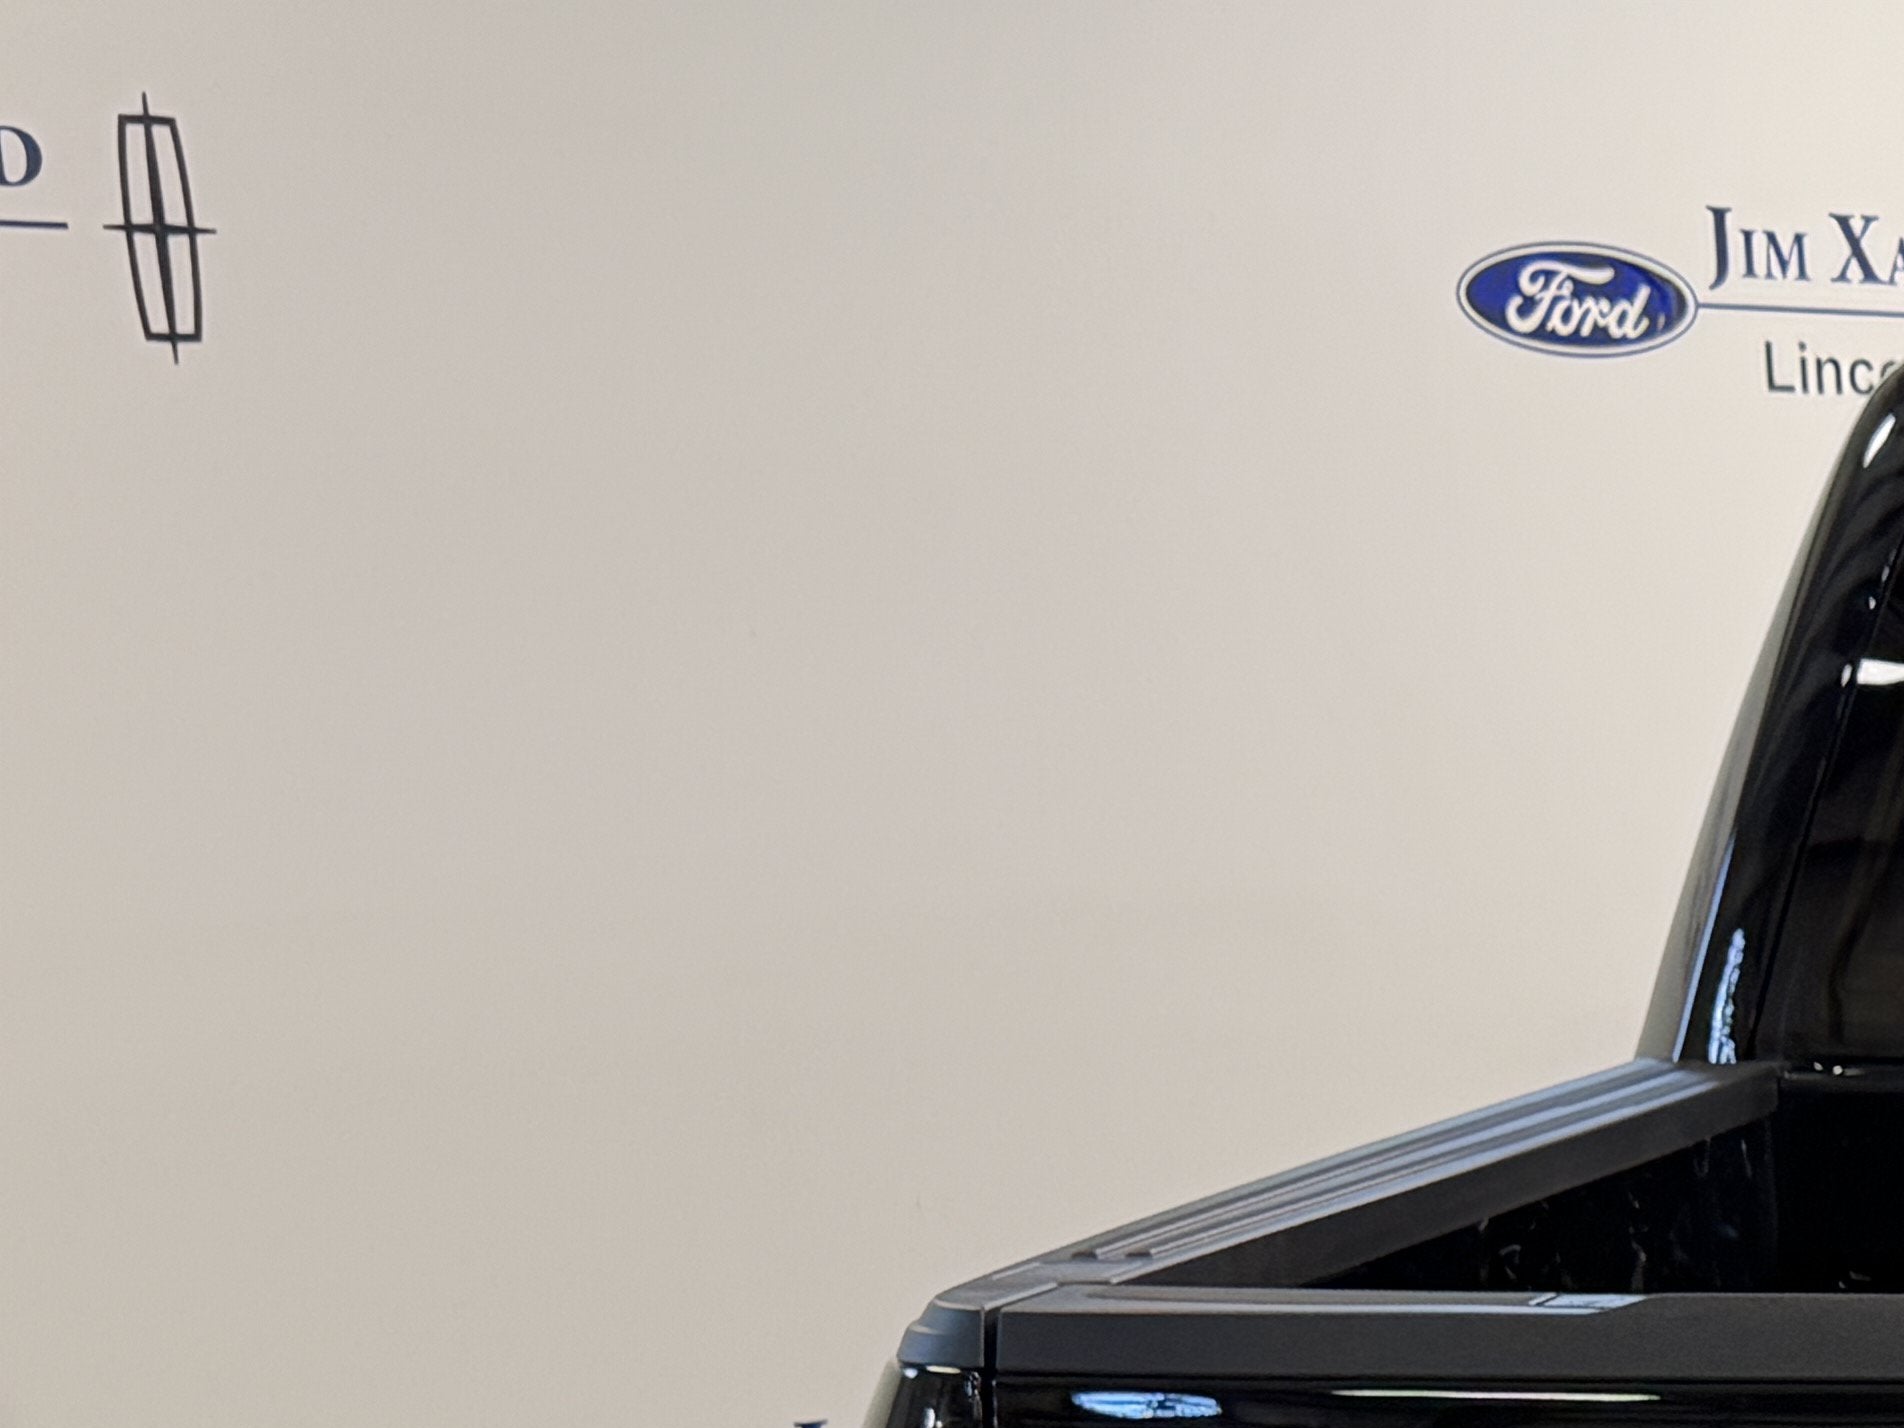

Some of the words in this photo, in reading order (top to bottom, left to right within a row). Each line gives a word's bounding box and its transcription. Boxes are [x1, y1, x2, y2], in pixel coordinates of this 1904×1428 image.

[1706, 205, 1810, 291] JIM
[1503, 260, 1650, 341] Ford
[1764, 340, 1895, 394] Linc
